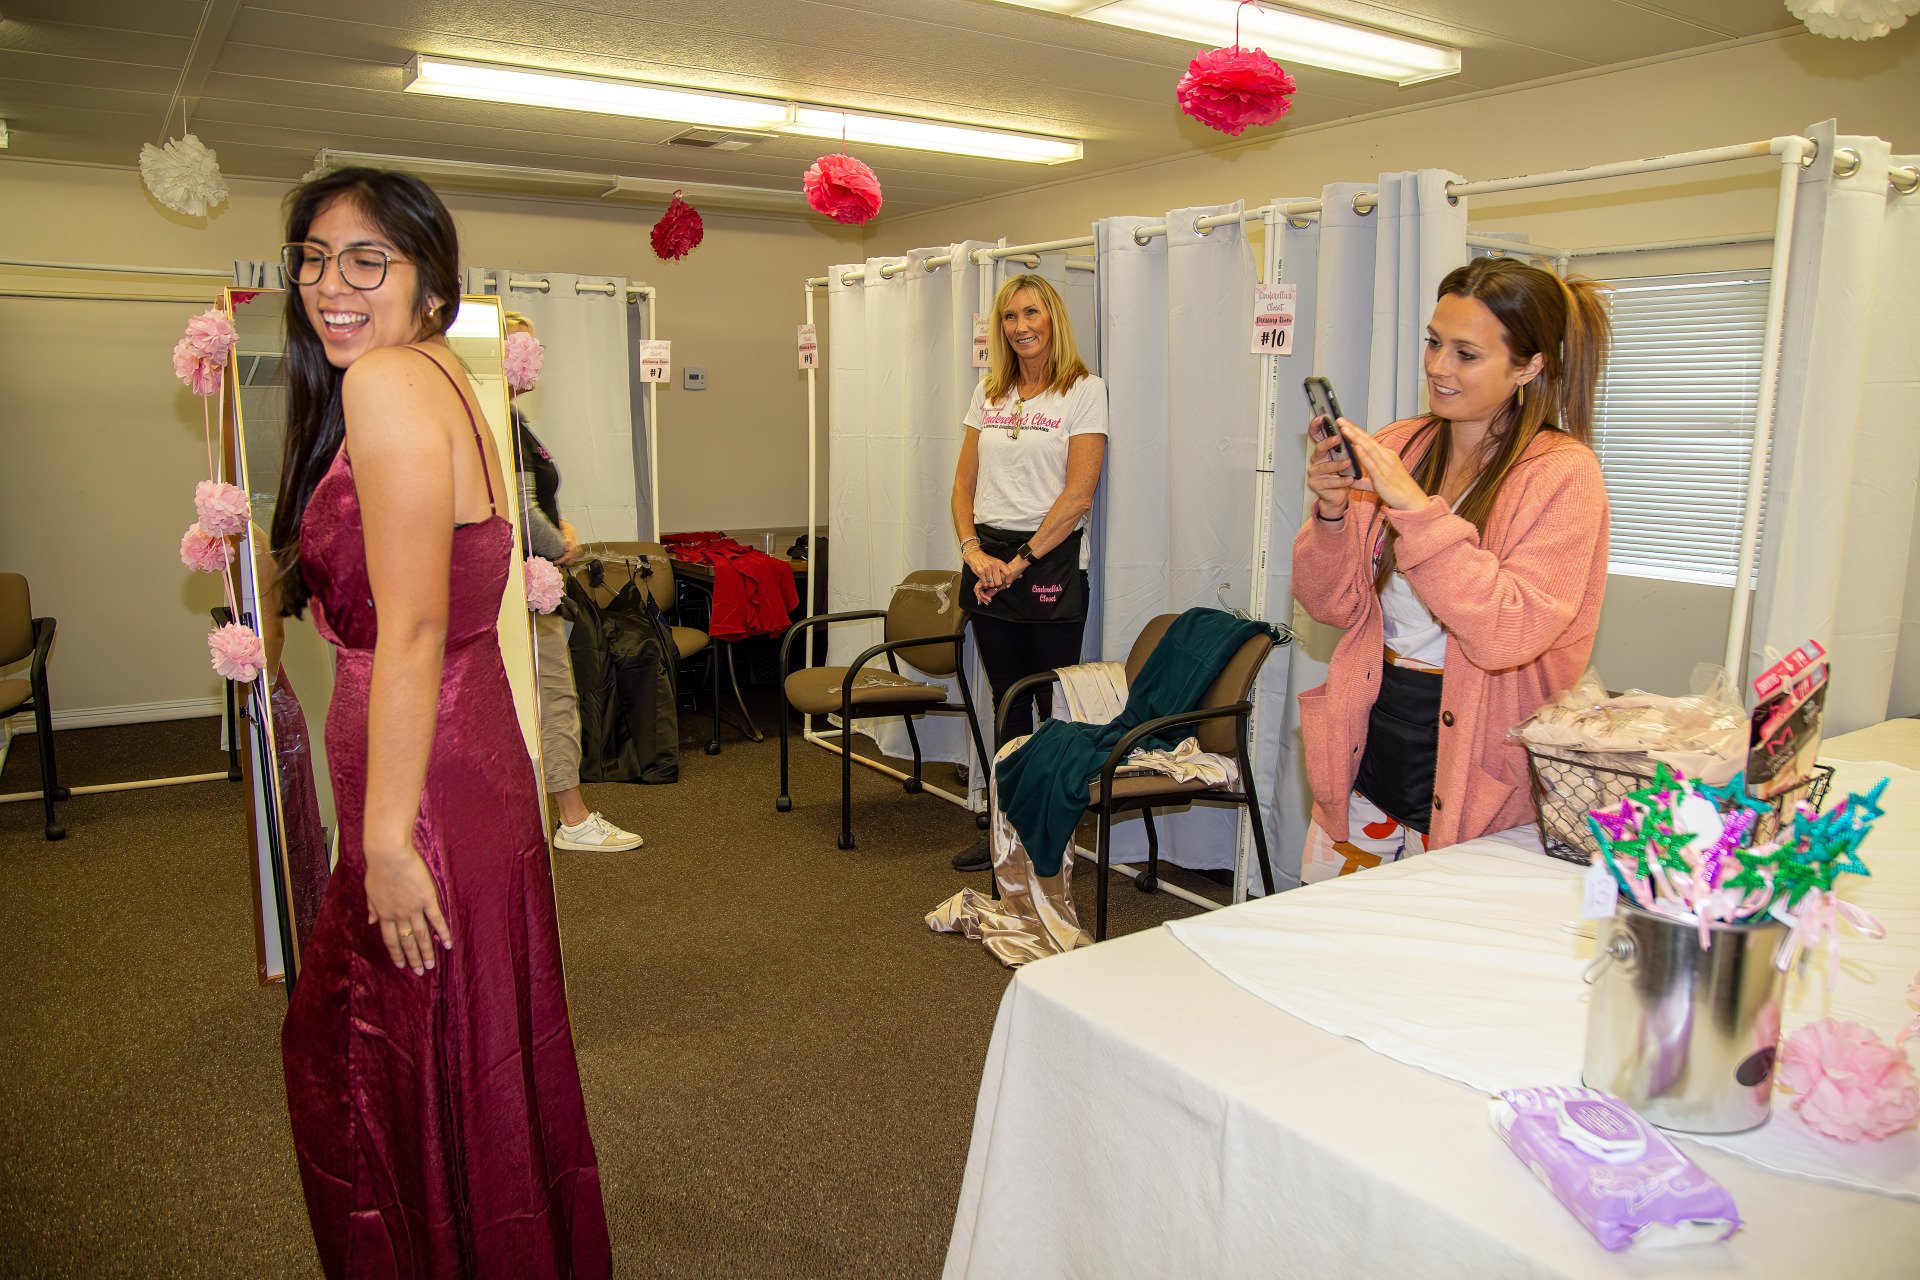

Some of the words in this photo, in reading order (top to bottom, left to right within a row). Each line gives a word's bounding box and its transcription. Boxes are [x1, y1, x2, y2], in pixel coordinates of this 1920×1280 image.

[1260, 328, 1285, 348] #10
[978, 347, 989, 362] #9
[649, 367, 662, 379] #7
[1031, 412, 1062, 429] Closet
[1031, 584, 1063, 593] Cinderella's
[1039, 594, 1057, 602] Closet
